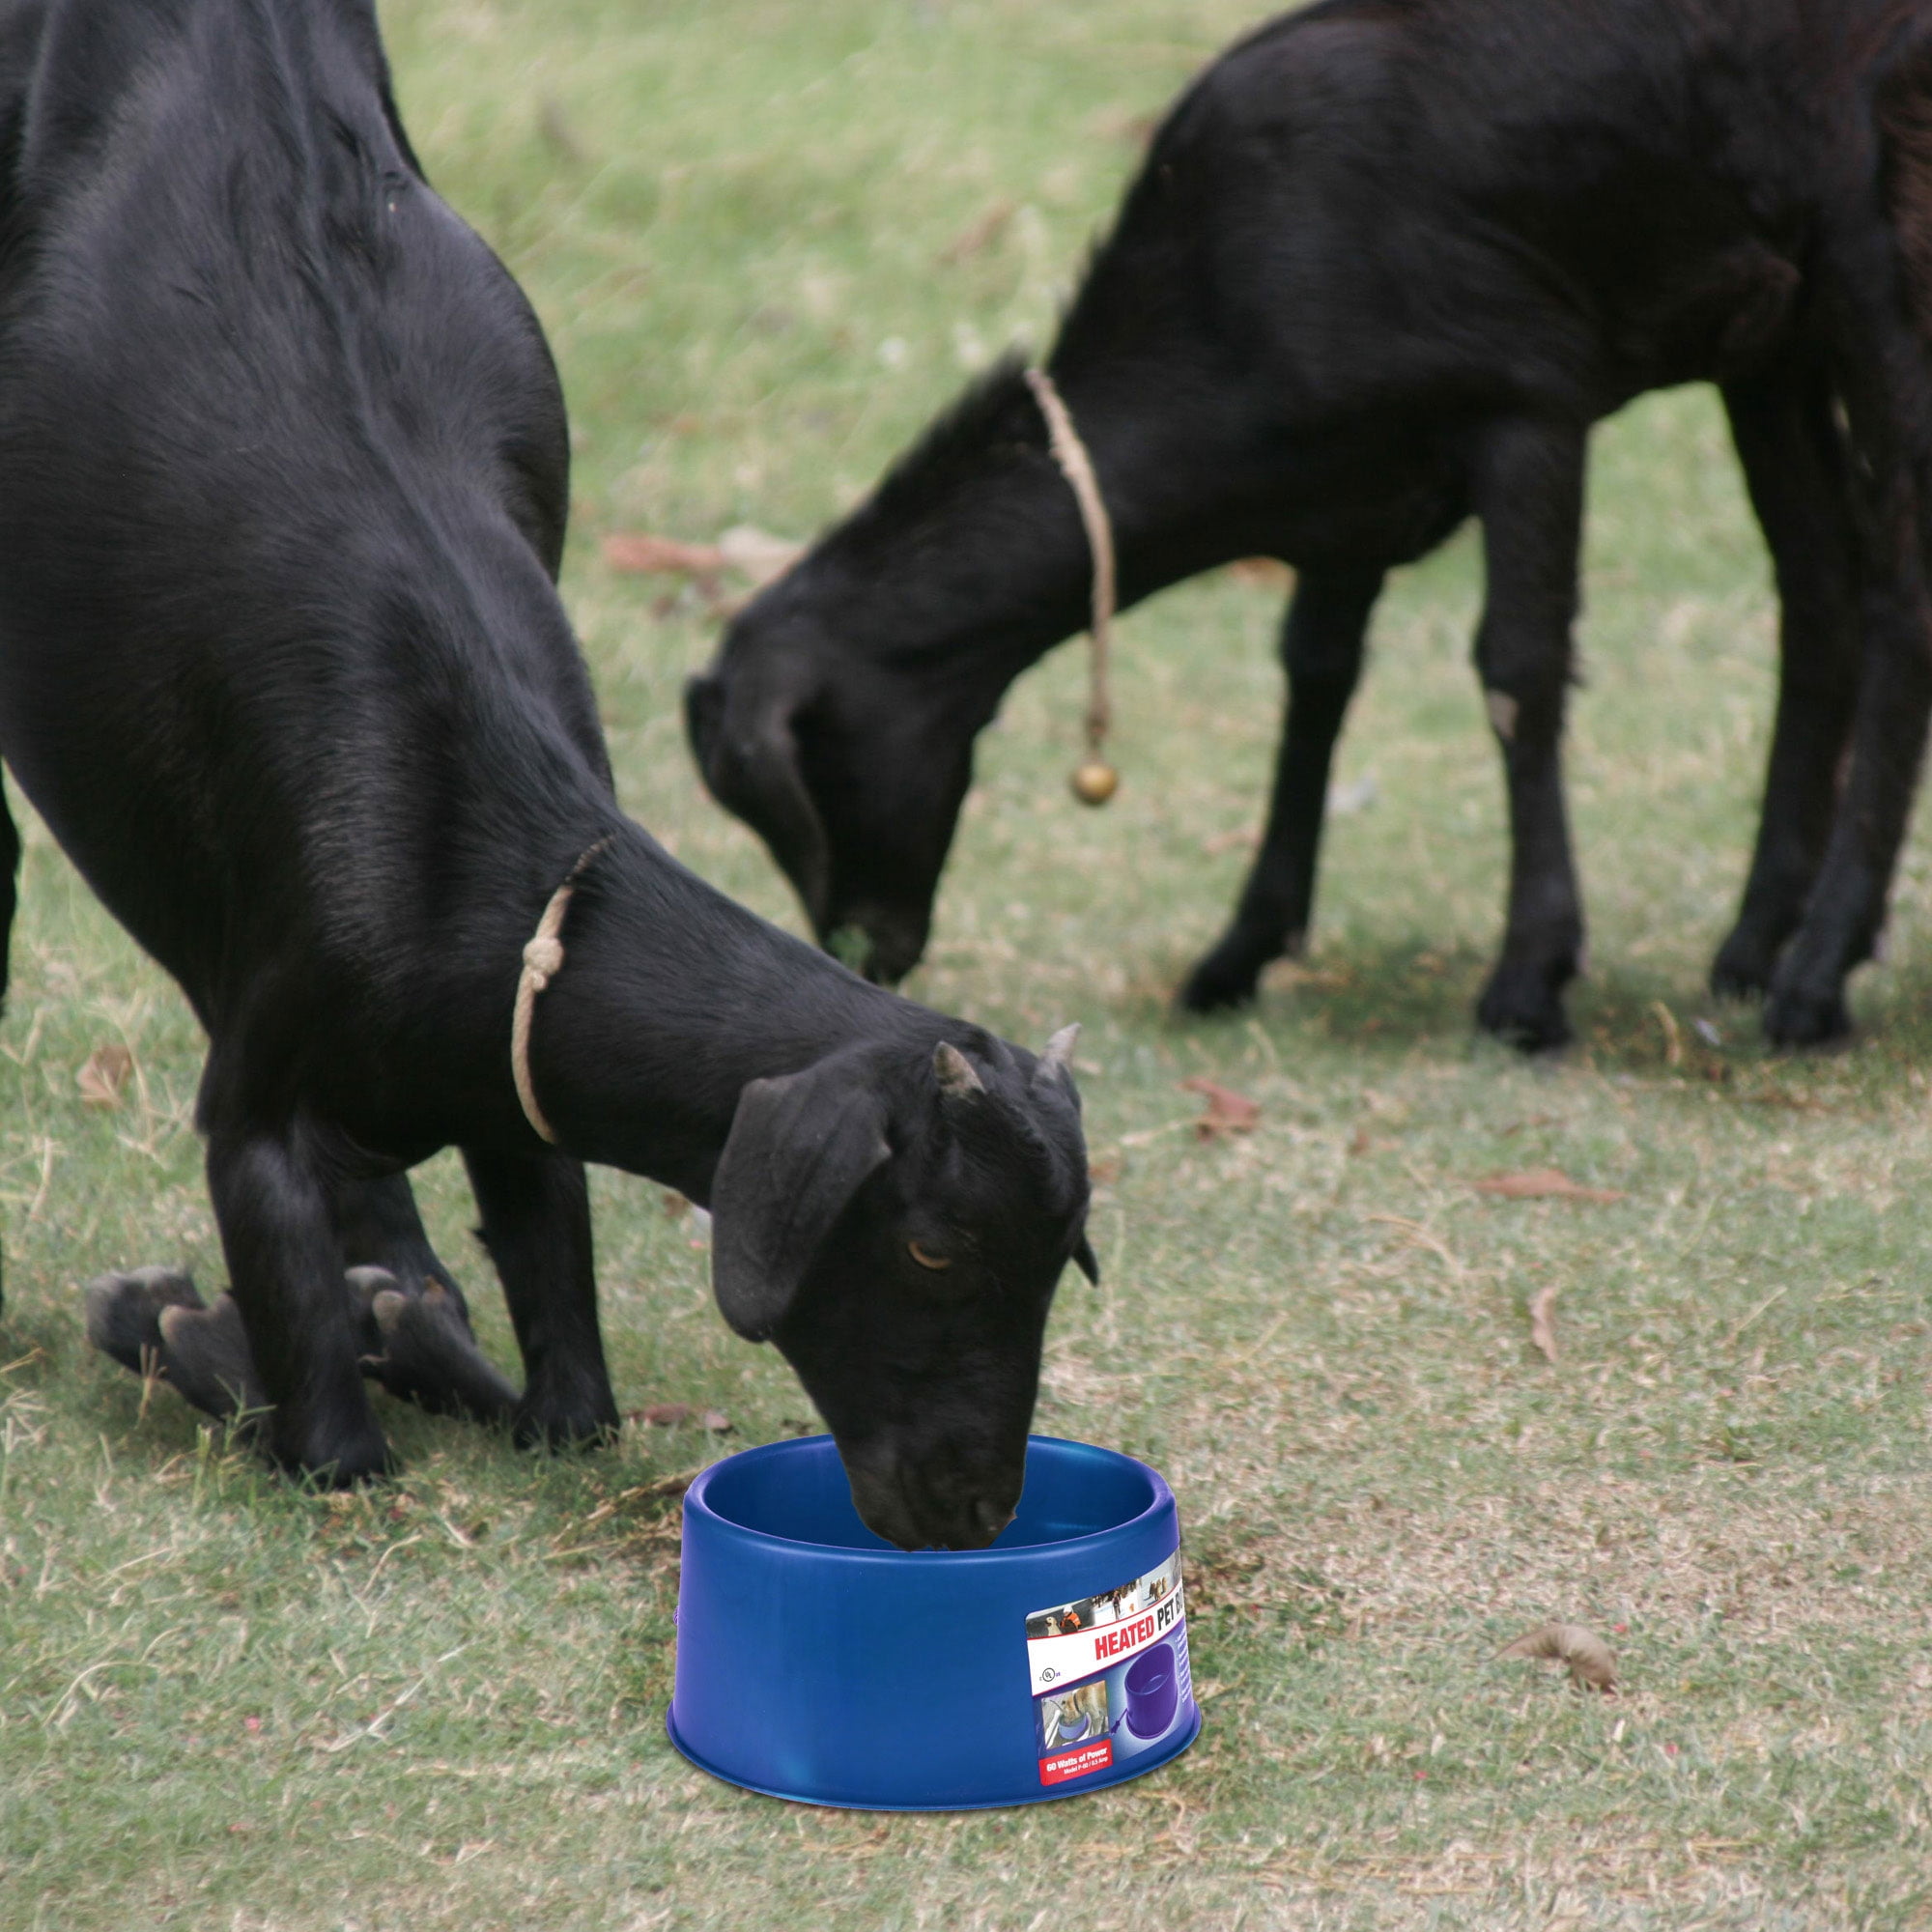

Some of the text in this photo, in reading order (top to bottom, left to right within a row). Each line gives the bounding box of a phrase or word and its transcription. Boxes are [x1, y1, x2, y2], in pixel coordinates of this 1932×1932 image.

[1094, 1614, 1154, 1661] HEATED
[1157, 1598, 1174, 1631] PET
[1046, 1747, 1108, 1772] 60 Watts of Power
[1064, 1766, 1078, 1775] Model
